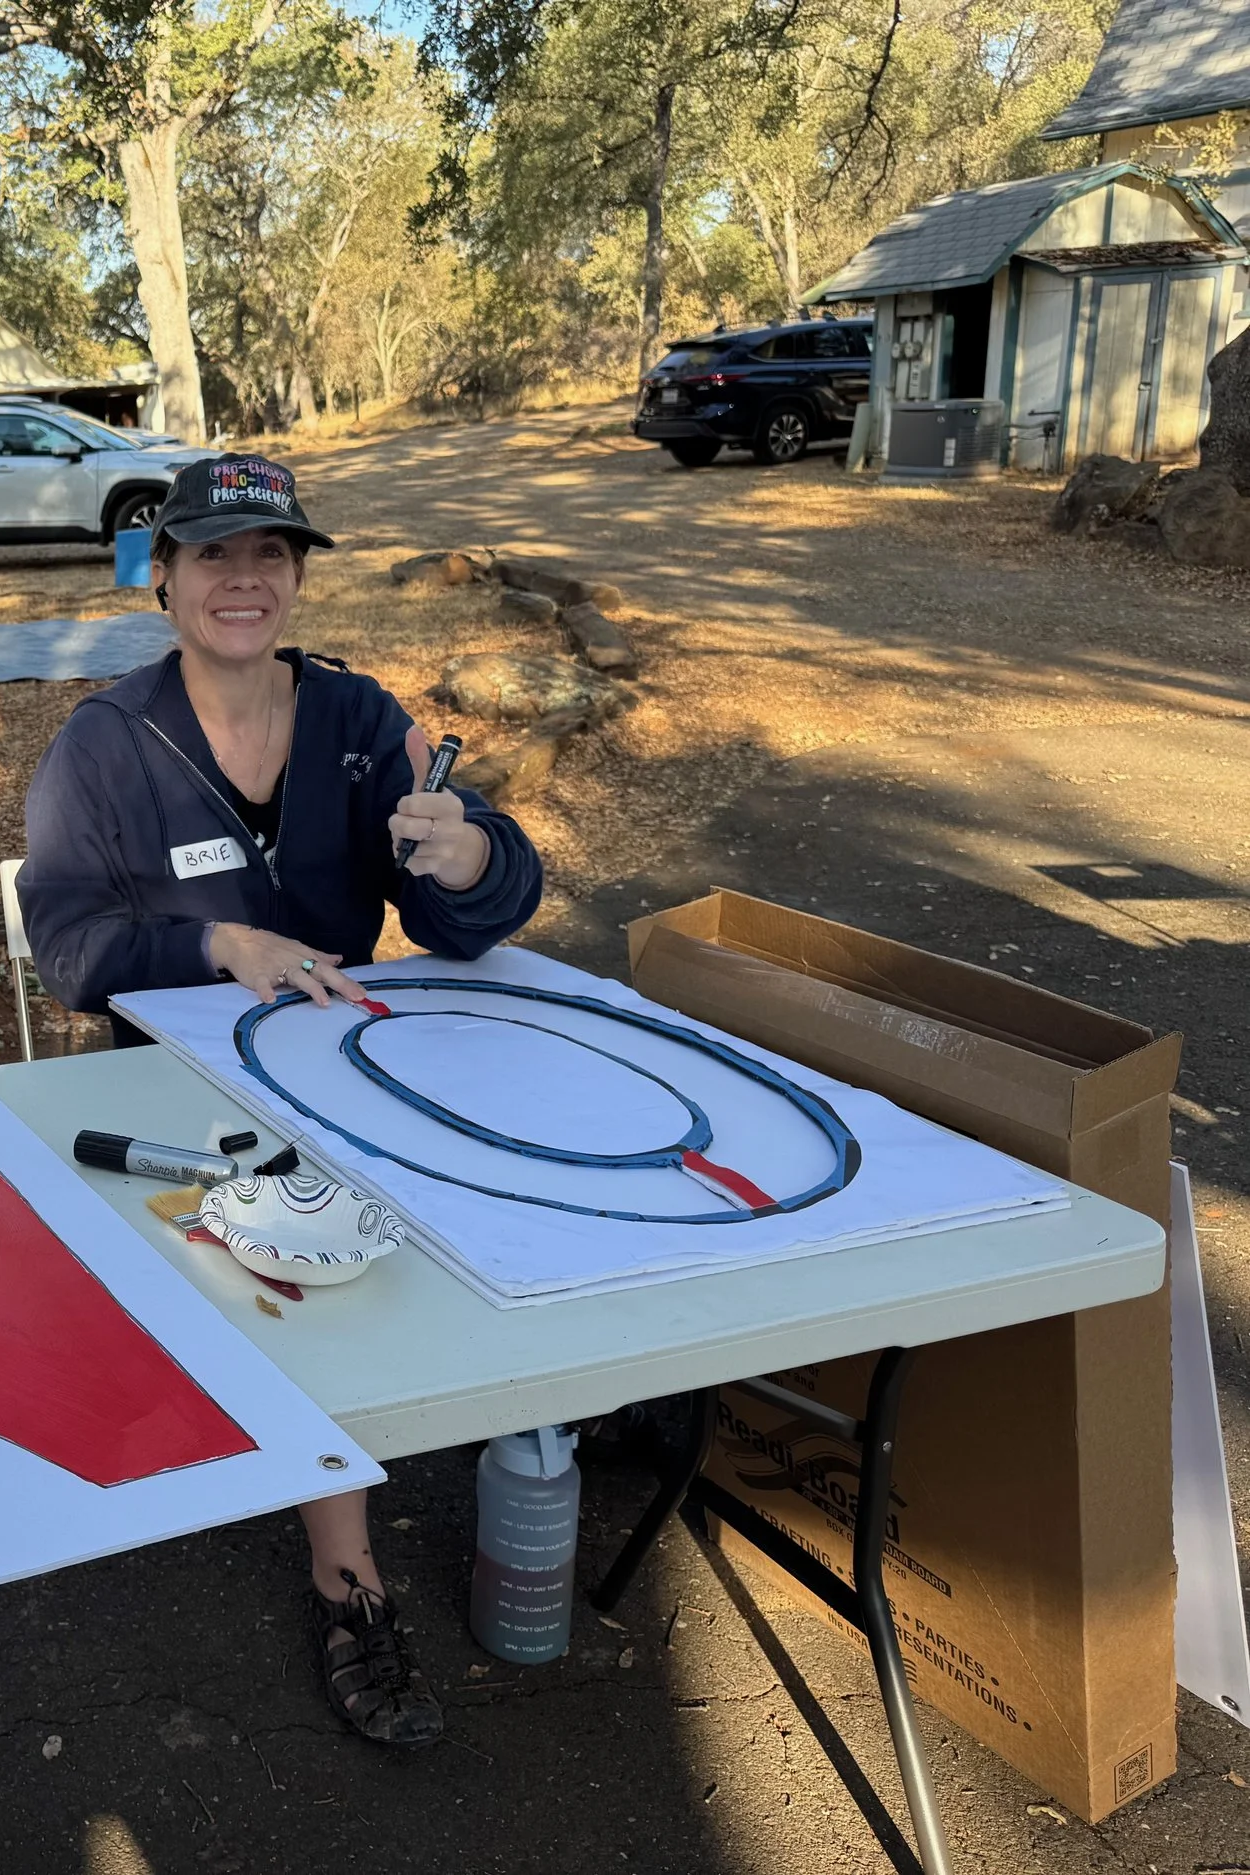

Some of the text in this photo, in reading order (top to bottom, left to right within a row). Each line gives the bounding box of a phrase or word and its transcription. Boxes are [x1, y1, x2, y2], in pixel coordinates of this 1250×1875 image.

[221, 474, 285, 493] PRO-LOVE
[184, 843, 231, 867] BRIE
[134, 1158, 216, 1181] Sharpie MAGNUM
[717, 1400, 900, 1545] Readi-Boad
[523, 1503, 543, 1511] GOOD
[511, 1543, 545, 1552] REMEMBER
[910, 1559, 948, 1593] BOARD
[516, 1584, 532, 1593] HALF
[514, 1605, 529, 1613] YOU
[514, 1625, 533, 1633] DON'T
[533, 1625, 548, 1633] QUIT
[846, 1625, 869, 1650] USA
[521, 1645, 535, 1653] YOU
[915, 1617, 985, 1680] PARTIES
[893, 1621, 1018, 1725] RESENTATIONS
